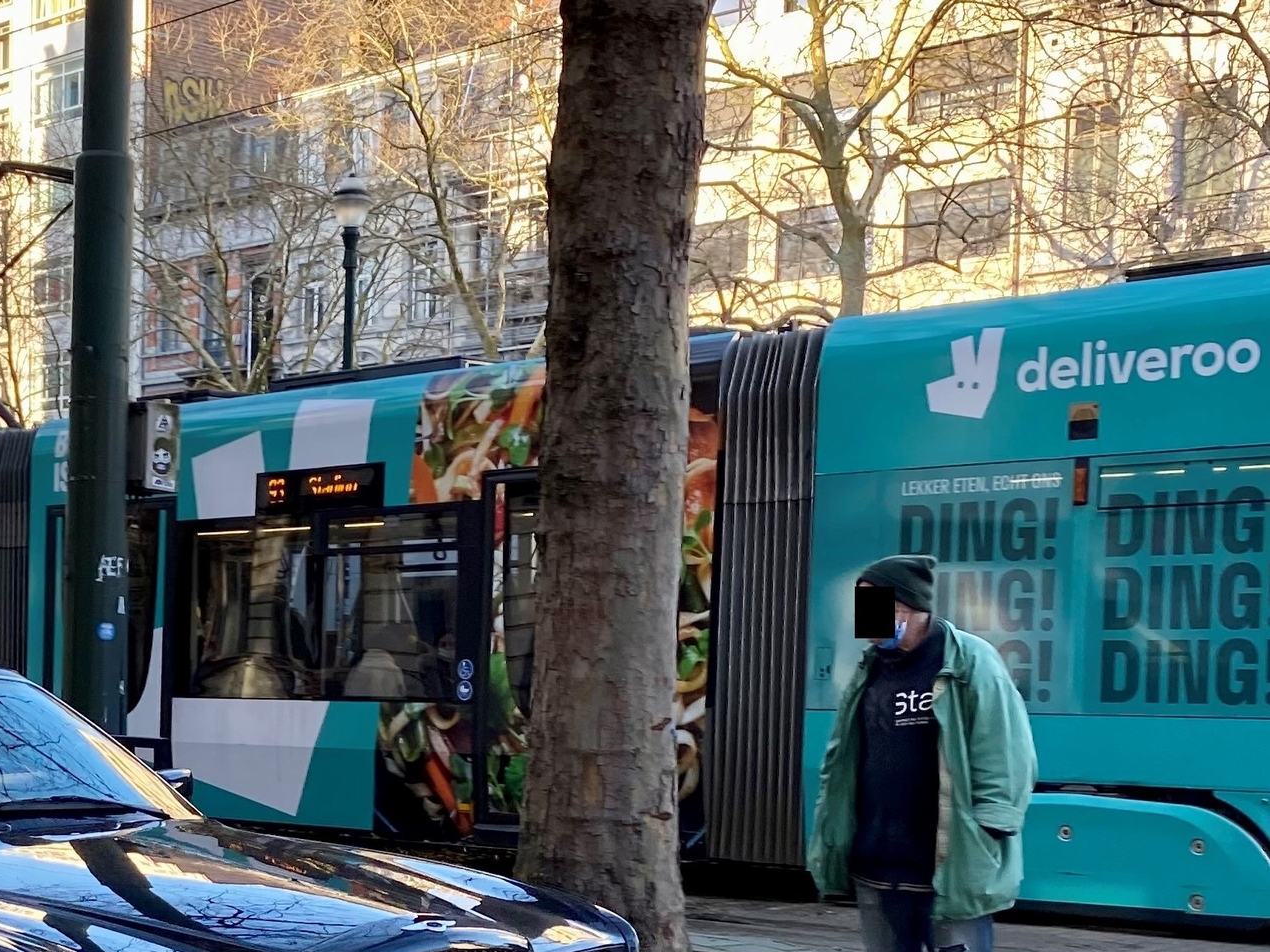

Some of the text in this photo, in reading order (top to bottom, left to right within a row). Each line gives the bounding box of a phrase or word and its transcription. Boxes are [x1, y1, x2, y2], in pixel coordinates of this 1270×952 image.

[1017, 338, 1261, 393] deliveroo
[902, 472, 1062, 496] LEKKER ETEN, ECHT ONS
[900, 497, 1059, 562] DING!
[936, 569, 1055, 632] ING!
[1102, 562, 1270, 631] DING
